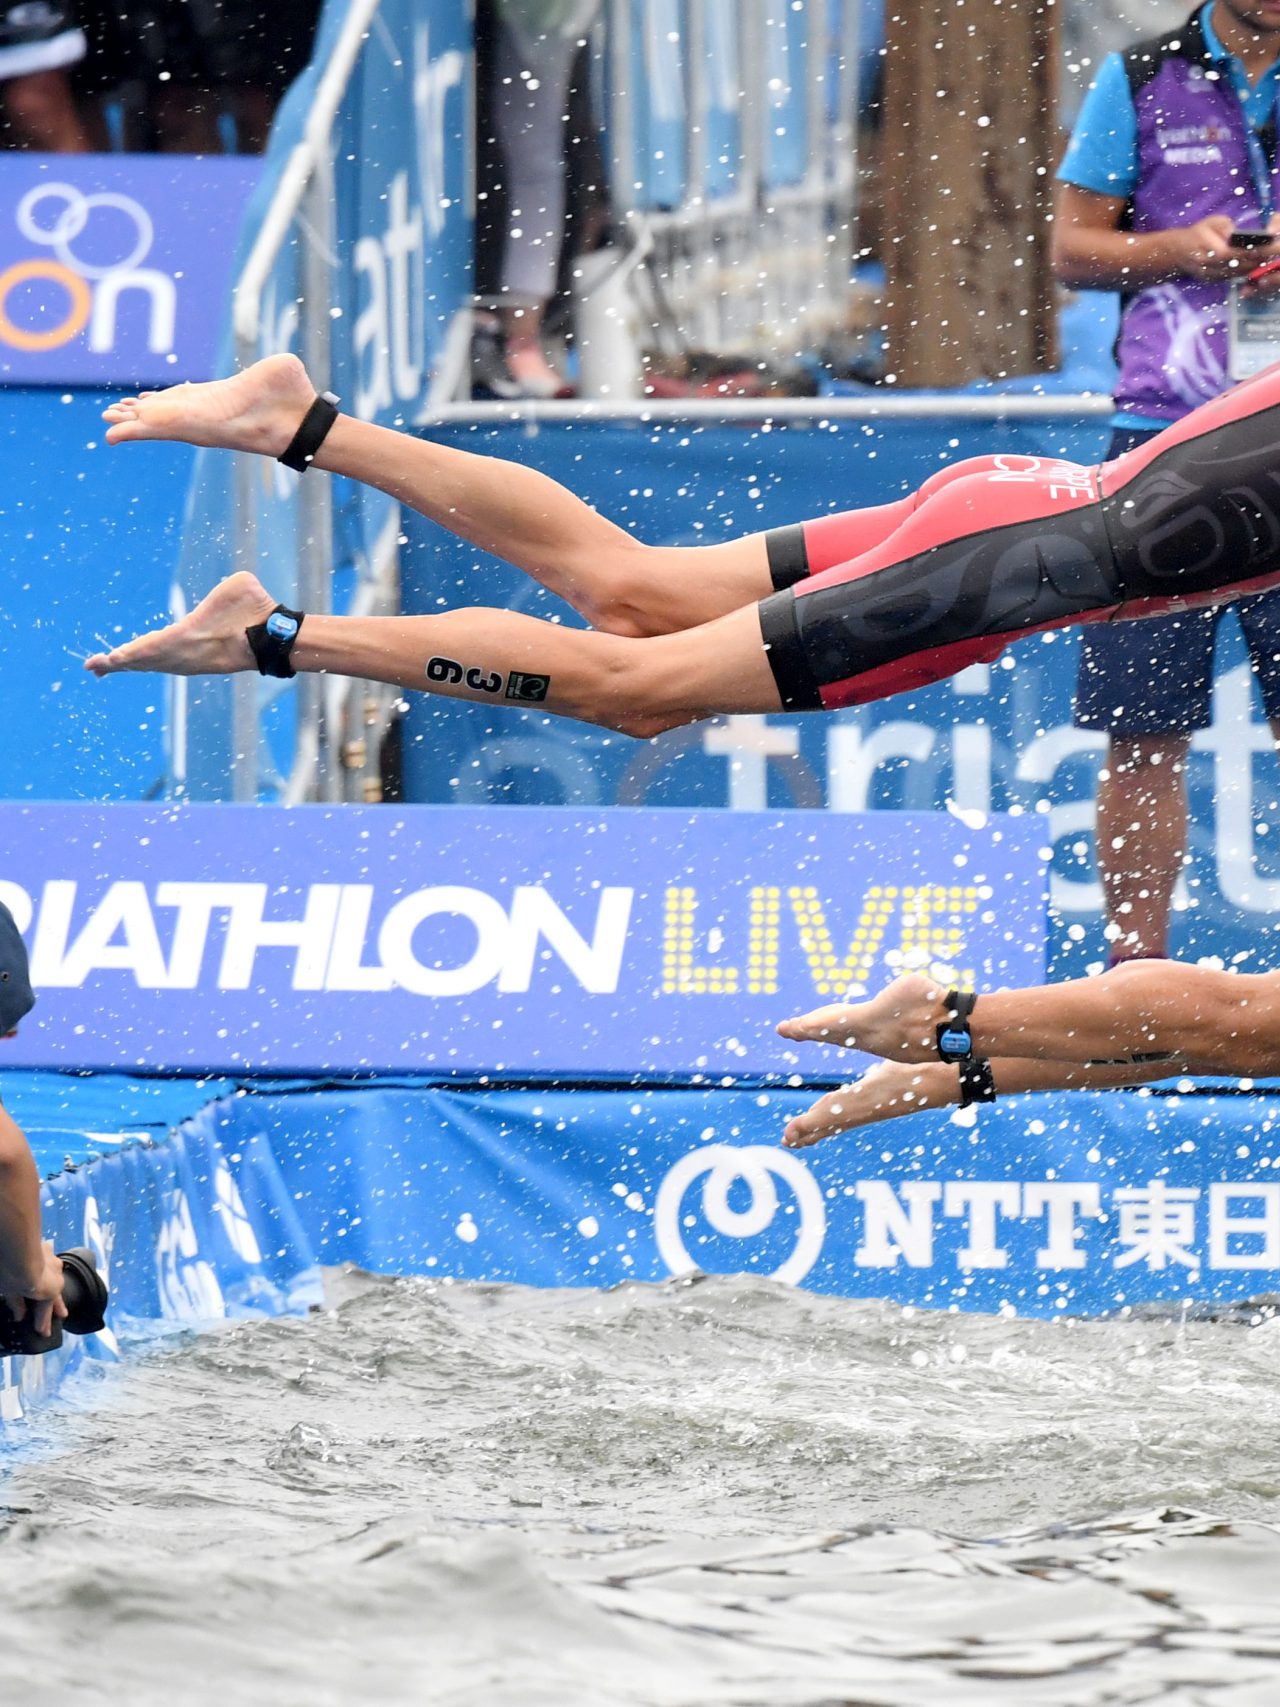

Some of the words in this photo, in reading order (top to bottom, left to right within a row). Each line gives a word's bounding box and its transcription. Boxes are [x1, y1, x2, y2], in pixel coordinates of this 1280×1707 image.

[426, 656, 503, 694] 36
[663, 885, 980, 996] LIVE
[854, 1180, 1100, 1269] NTT
